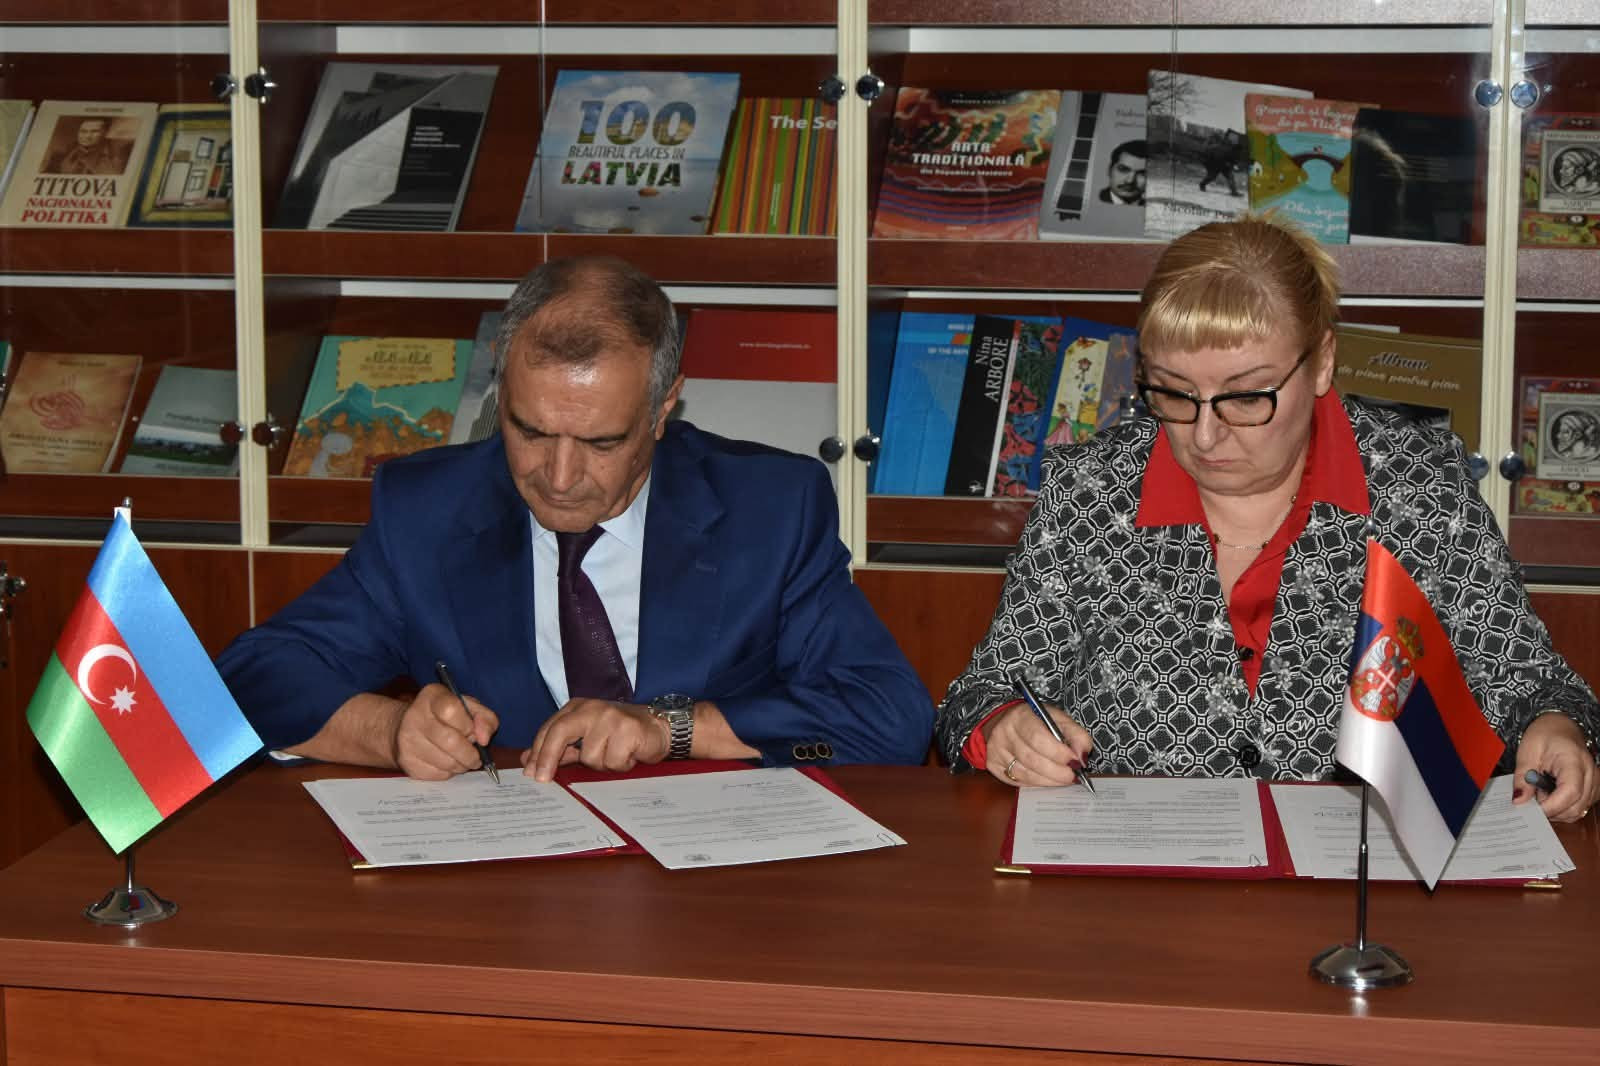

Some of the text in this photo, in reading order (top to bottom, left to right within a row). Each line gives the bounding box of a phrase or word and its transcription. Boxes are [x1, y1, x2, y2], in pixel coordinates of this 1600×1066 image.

[576, 100, 697, 146] 100
[770, 115, 809, 129] The
[568, 145, 686, 160] BEAUTIFUL PLACES IN
[951, 142, 991, 153] ARTA
[561, 161, 681, 186] LATVIA
[33, 177, 118, 197] TITOVA
[26, 197, 113, 209] NACIONALNA
[21, 209, 108, 224] POLITIKA
[975, 335, 993, 365] Nina
[1368, 351, 1432, 370] Album
[984, 338, 1009, 403] ARBORE
